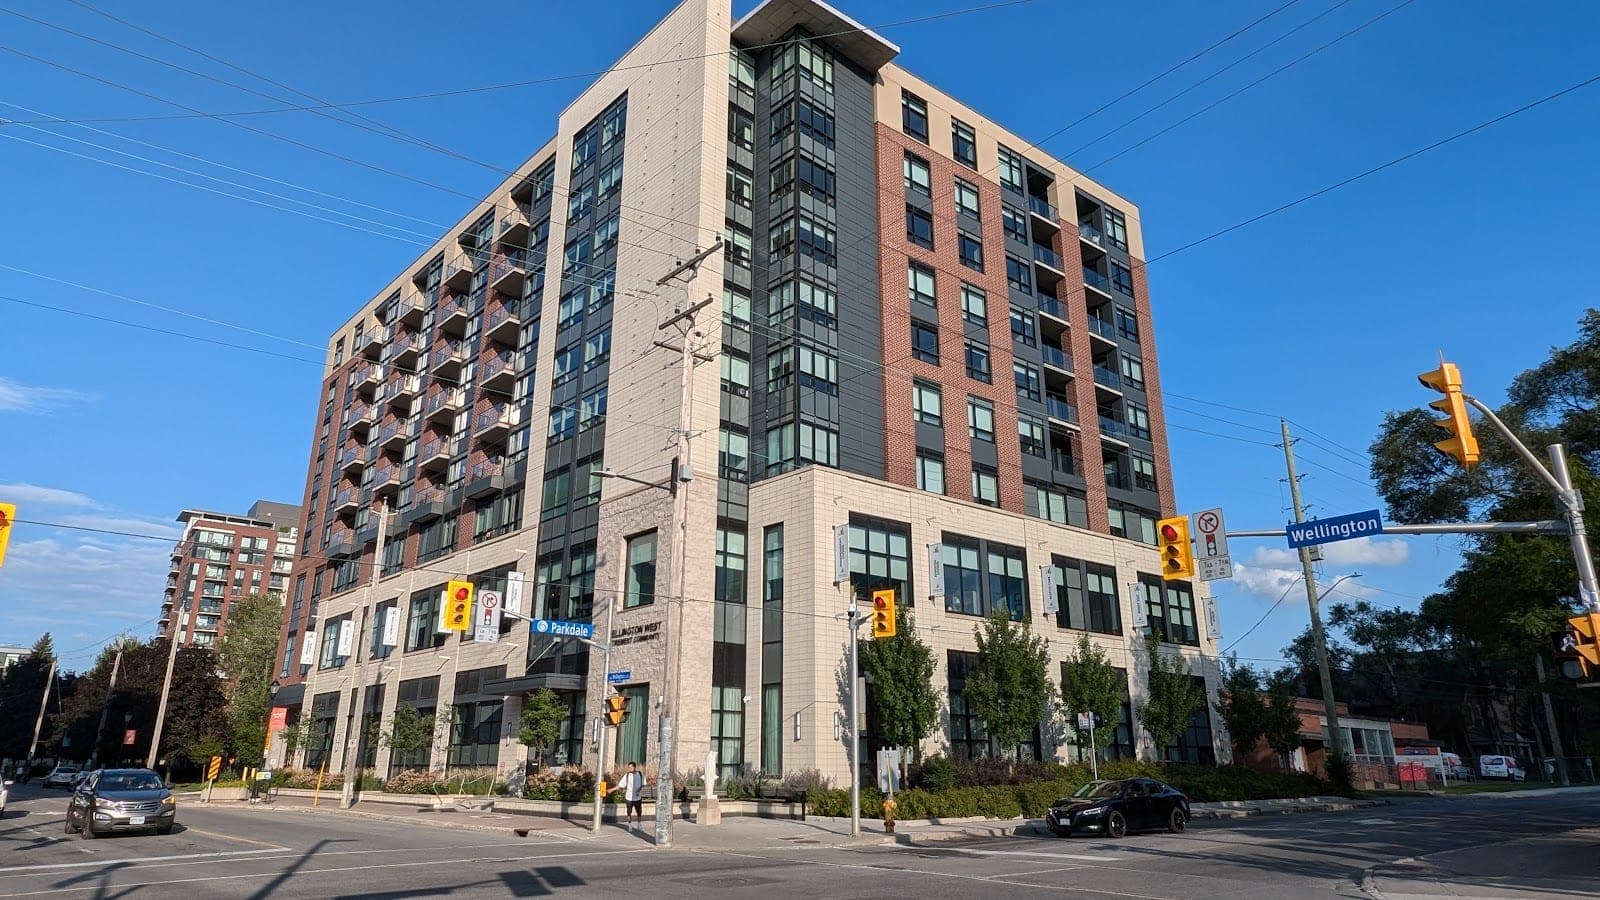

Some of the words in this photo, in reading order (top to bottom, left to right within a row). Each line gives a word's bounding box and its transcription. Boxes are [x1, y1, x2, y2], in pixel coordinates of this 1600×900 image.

[1291, 518, 1378, 543] Wellington
[551, 622, 589, 637] Parkdale
[611, 624, 643, 639] ELLINGTON
[644, 621, 662, 632] WEST
